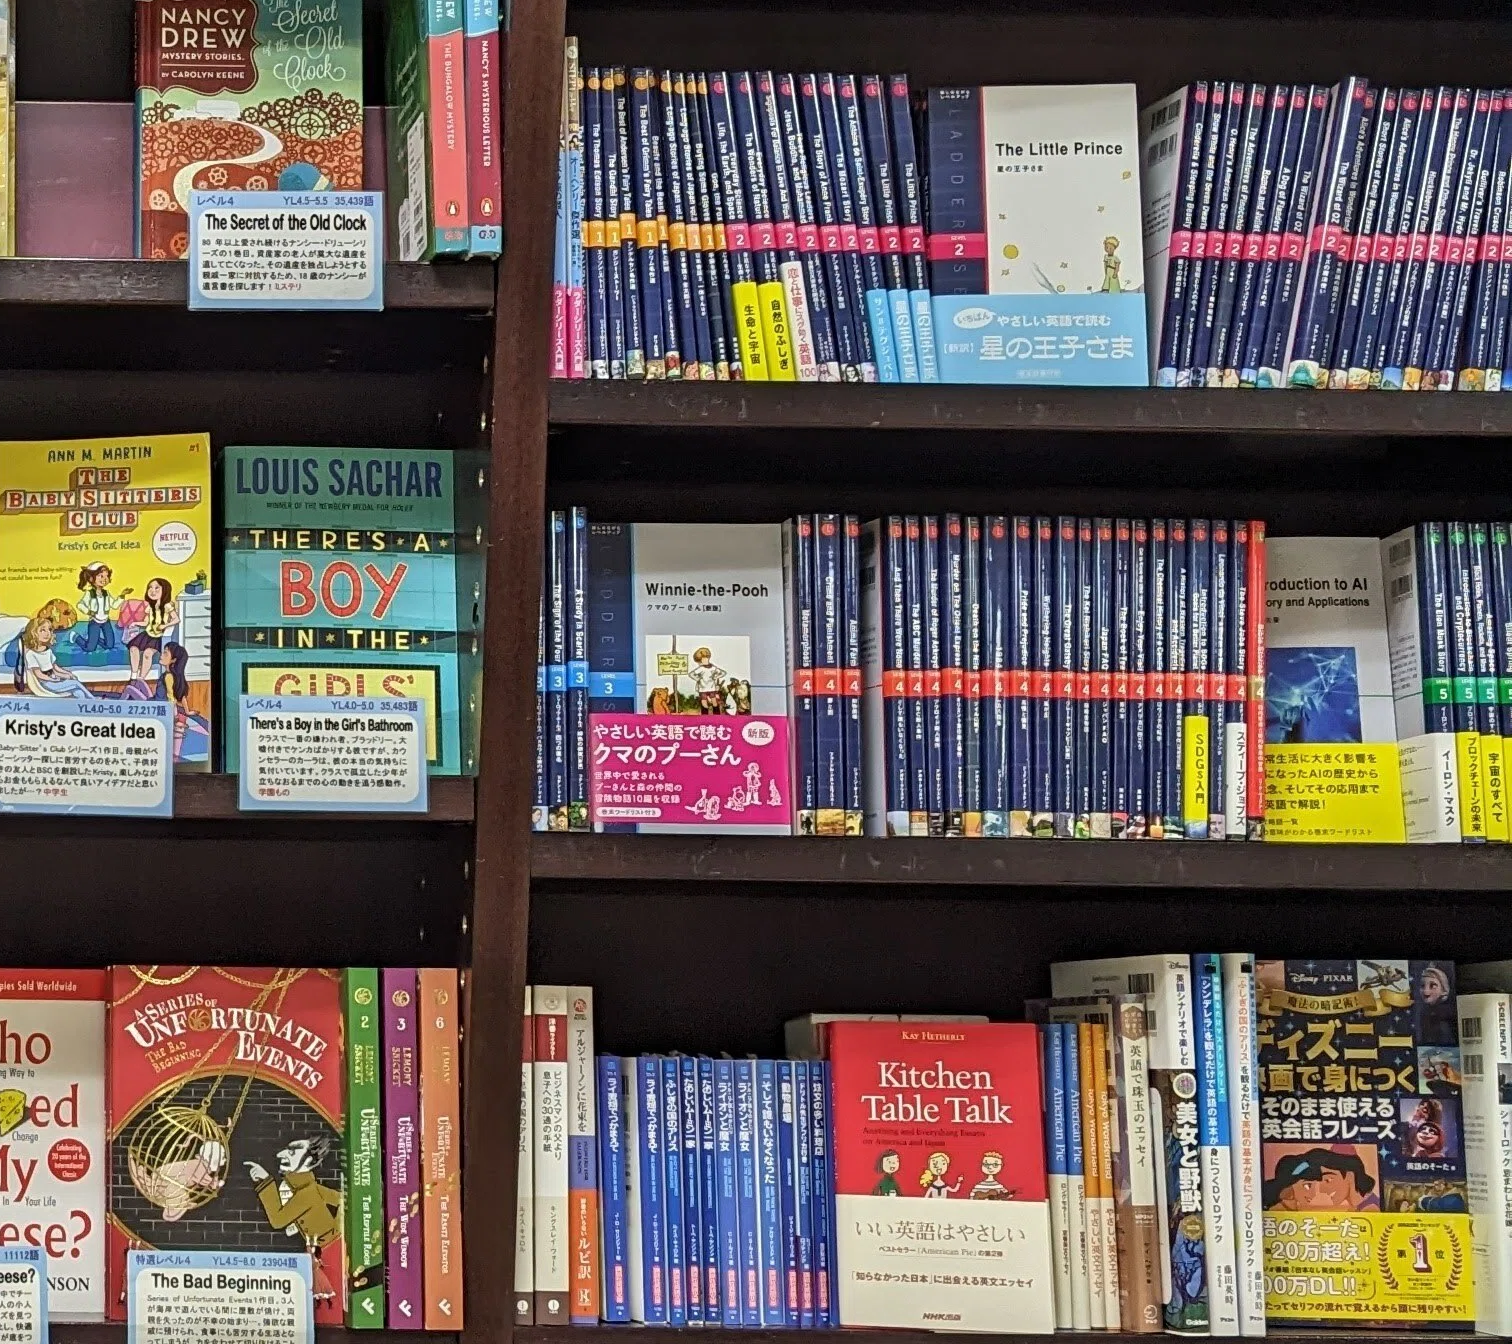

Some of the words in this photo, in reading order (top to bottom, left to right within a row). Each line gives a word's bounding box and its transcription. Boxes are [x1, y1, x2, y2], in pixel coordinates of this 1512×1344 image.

[161, 6, 246, 26] NANCY
[161, 28, 245, 48] DREW
[162, 53, 203, 62] MYSTERY
[171, 70, 211, 79] CAROLYN
[215, 70, 246, 79] KEENE
[995, 142, 1022, 158] The
[1028, 141, 1069, 158] Little
[1074, 140, 1123, 158] Prince
[205, 213, 231, 231] The
[234, 213, 271, 231] Secret
[273, 213, 287, 231] of
[289, 214, 307, 231] the
[311, 214, 332, 232] Old
[335, 214, 367, 232] Clock
[996, 312, 1111, 329] やさしい英語で読む
[744, 304, 760, 365] 生命と宇宙
[771, 300, 788, 370] 自然のふしぎ
[979, 331, 1134, 362] 星の王子さま
[236, 457, 320, 497] LOUIS
[329, 457, 442, 499] SACHAR
[279, 560, 409, 621] BOY
[645, 581, 769, 601] Winnie-the-Pooh
[595, 744, 741, 766] クマのプーさん
[1442, 750, 1454, 827] イーロン・マスク
[17, 981, 32, 991] Sold
[35, 981, 76, 991] Worldwide
[902, 1030, 919, 1041] KAY
[922, 1030, 966, 1042] HETHERLY
[878, 1062, 994, 1090] Kitchen
[862, 1094, 938, 1125] Table
[944, 1094, 1012, 1125] Talk
[1262, 1118, 1396, 1140] 英会話フレーズ
[1176, 1101, 1202, 1212] 美女と野獣
[854, 1219, 1026, 1243] いい英語はやさしい
